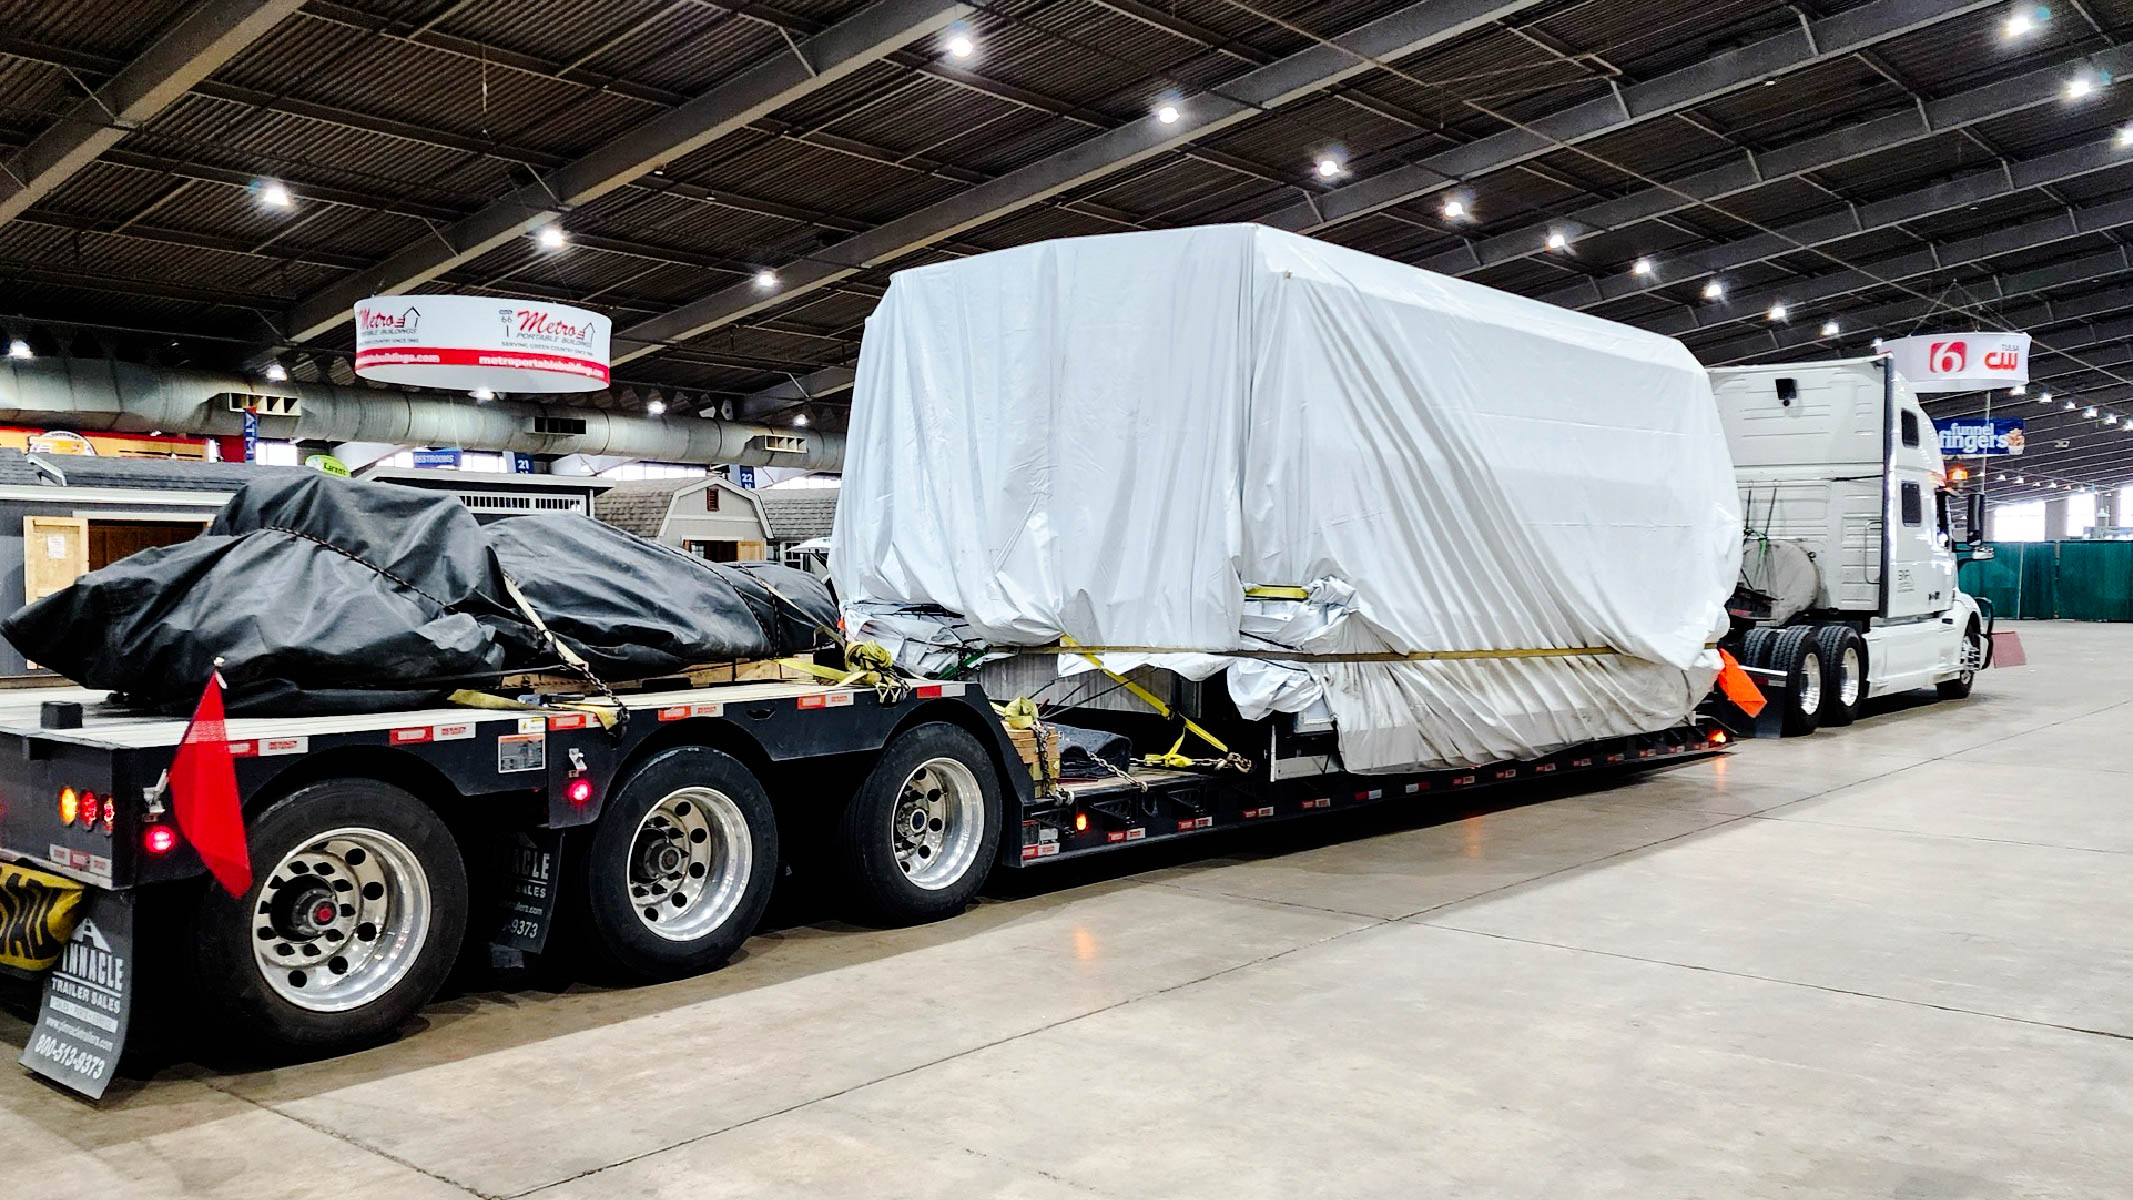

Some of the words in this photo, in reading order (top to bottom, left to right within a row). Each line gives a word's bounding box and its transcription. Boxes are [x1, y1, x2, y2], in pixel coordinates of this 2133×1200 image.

[517, 310, 577, 335] Metro
[1932, 342, 1966, 374] 6
[245, 413, 256, 455] ATM
[1939, 430, 2009, 453] fingers
[1951, 423, 1995, 436] funnel
[518, 460, 530, 469] 21
[741, 473, 753, 483] 22
[62, 942, 124, 991] INNACLE
[52, 976, 90, 1003] TRAILER
[91, 991, 121, 1014] SALES
[35, 1033, 106, 1079] 800-513-9373
